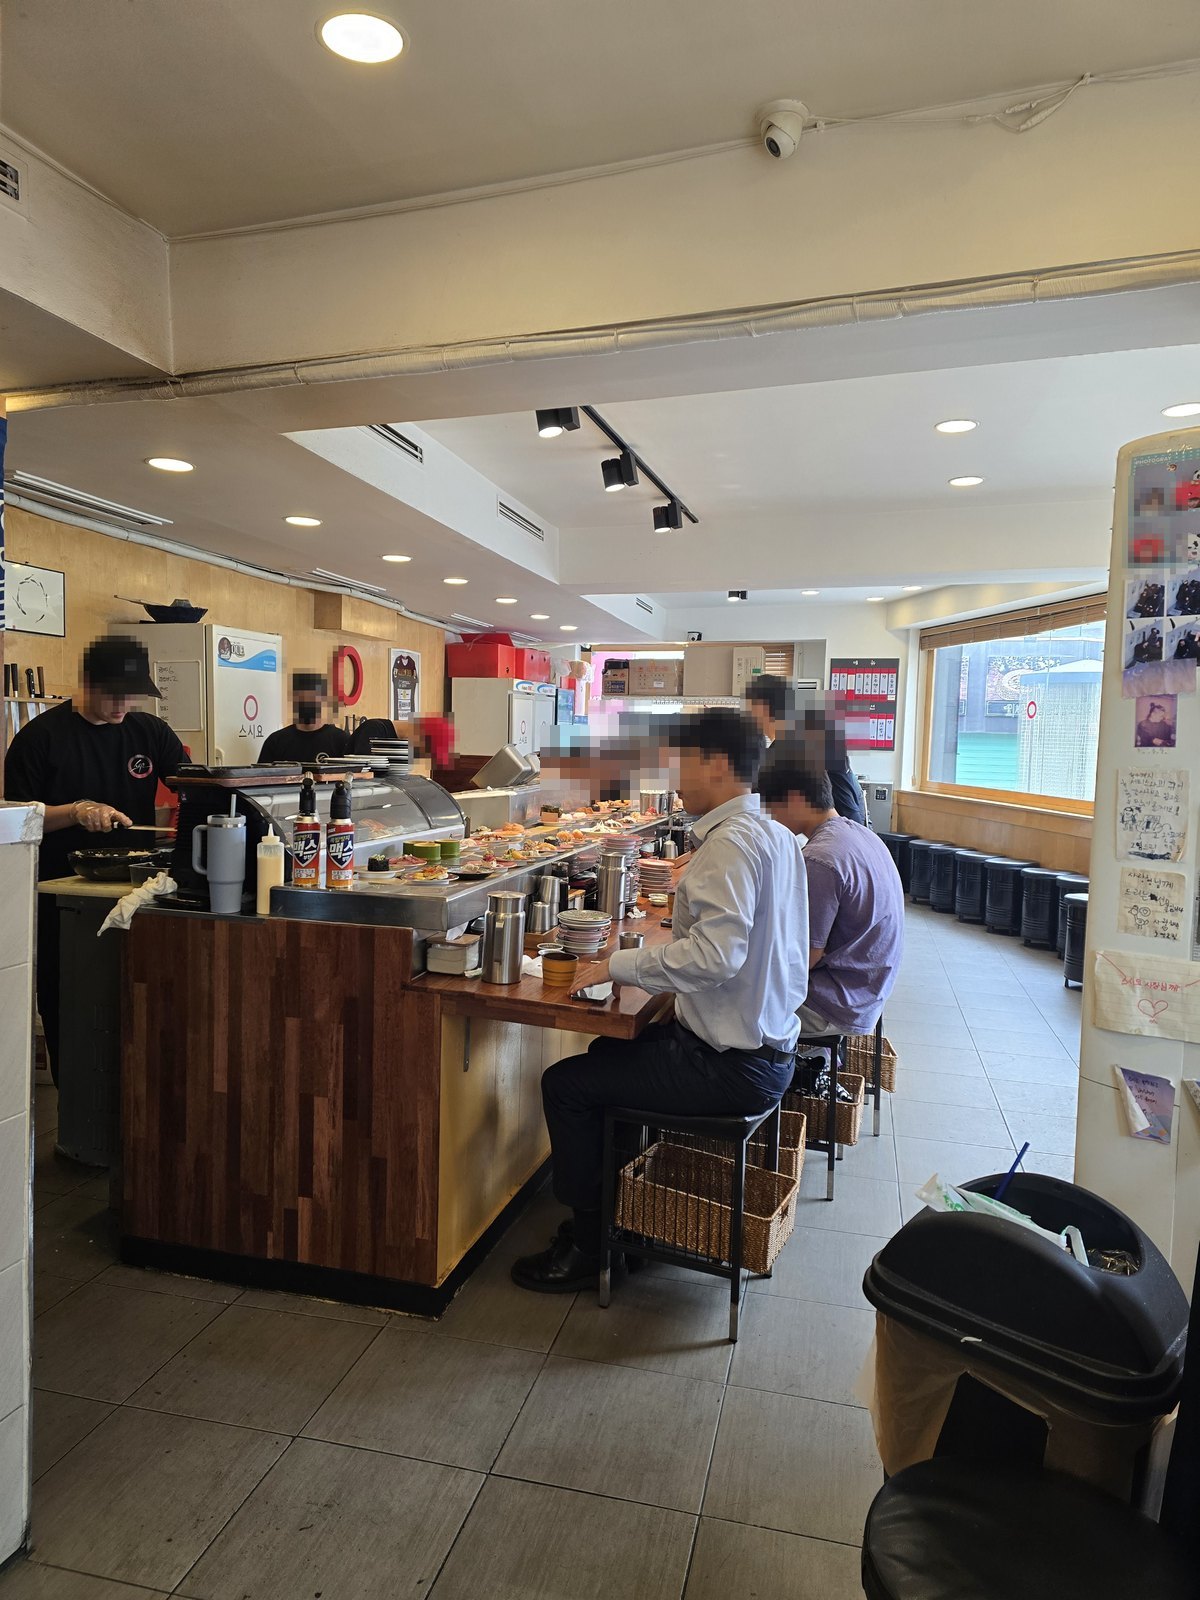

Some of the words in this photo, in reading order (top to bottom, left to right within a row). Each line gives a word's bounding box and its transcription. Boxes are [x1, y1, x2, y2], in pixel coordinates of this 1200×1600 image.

[239, 724, 264, 739] 스시요
[293, 839, 318, 857] 맥스
[329, 840, 353, 859] 맥스
